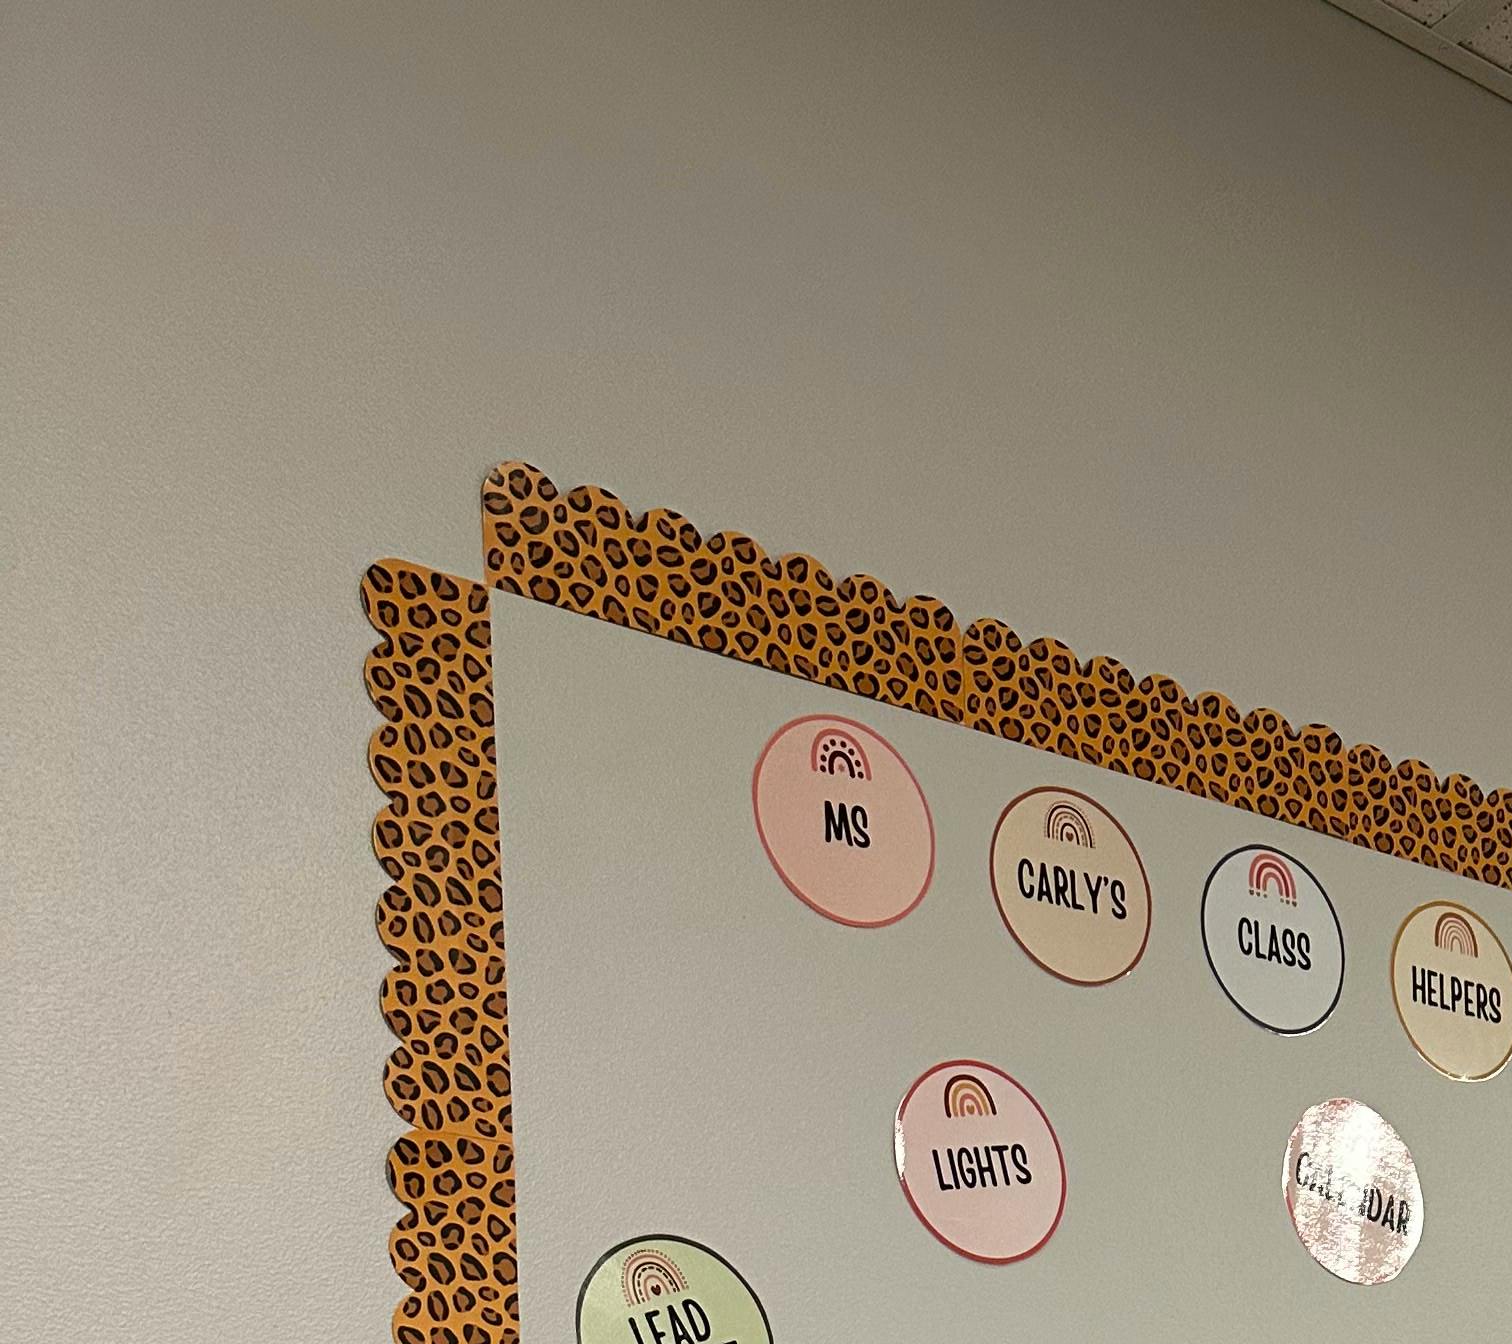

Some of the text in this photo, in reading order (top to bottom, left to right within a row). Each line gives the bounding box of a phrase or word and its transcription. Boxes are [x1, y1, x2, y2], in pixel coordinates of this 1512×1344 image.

[825, 801, 870, 848] MS
[1018, 859, 1126, 919] CARLY'S
[1238, 918, 1311, 970] CLASS
[1412, 966, 1501, 1023] HELPERS
[932, 1144, 1031, 1190] LIGHTS
